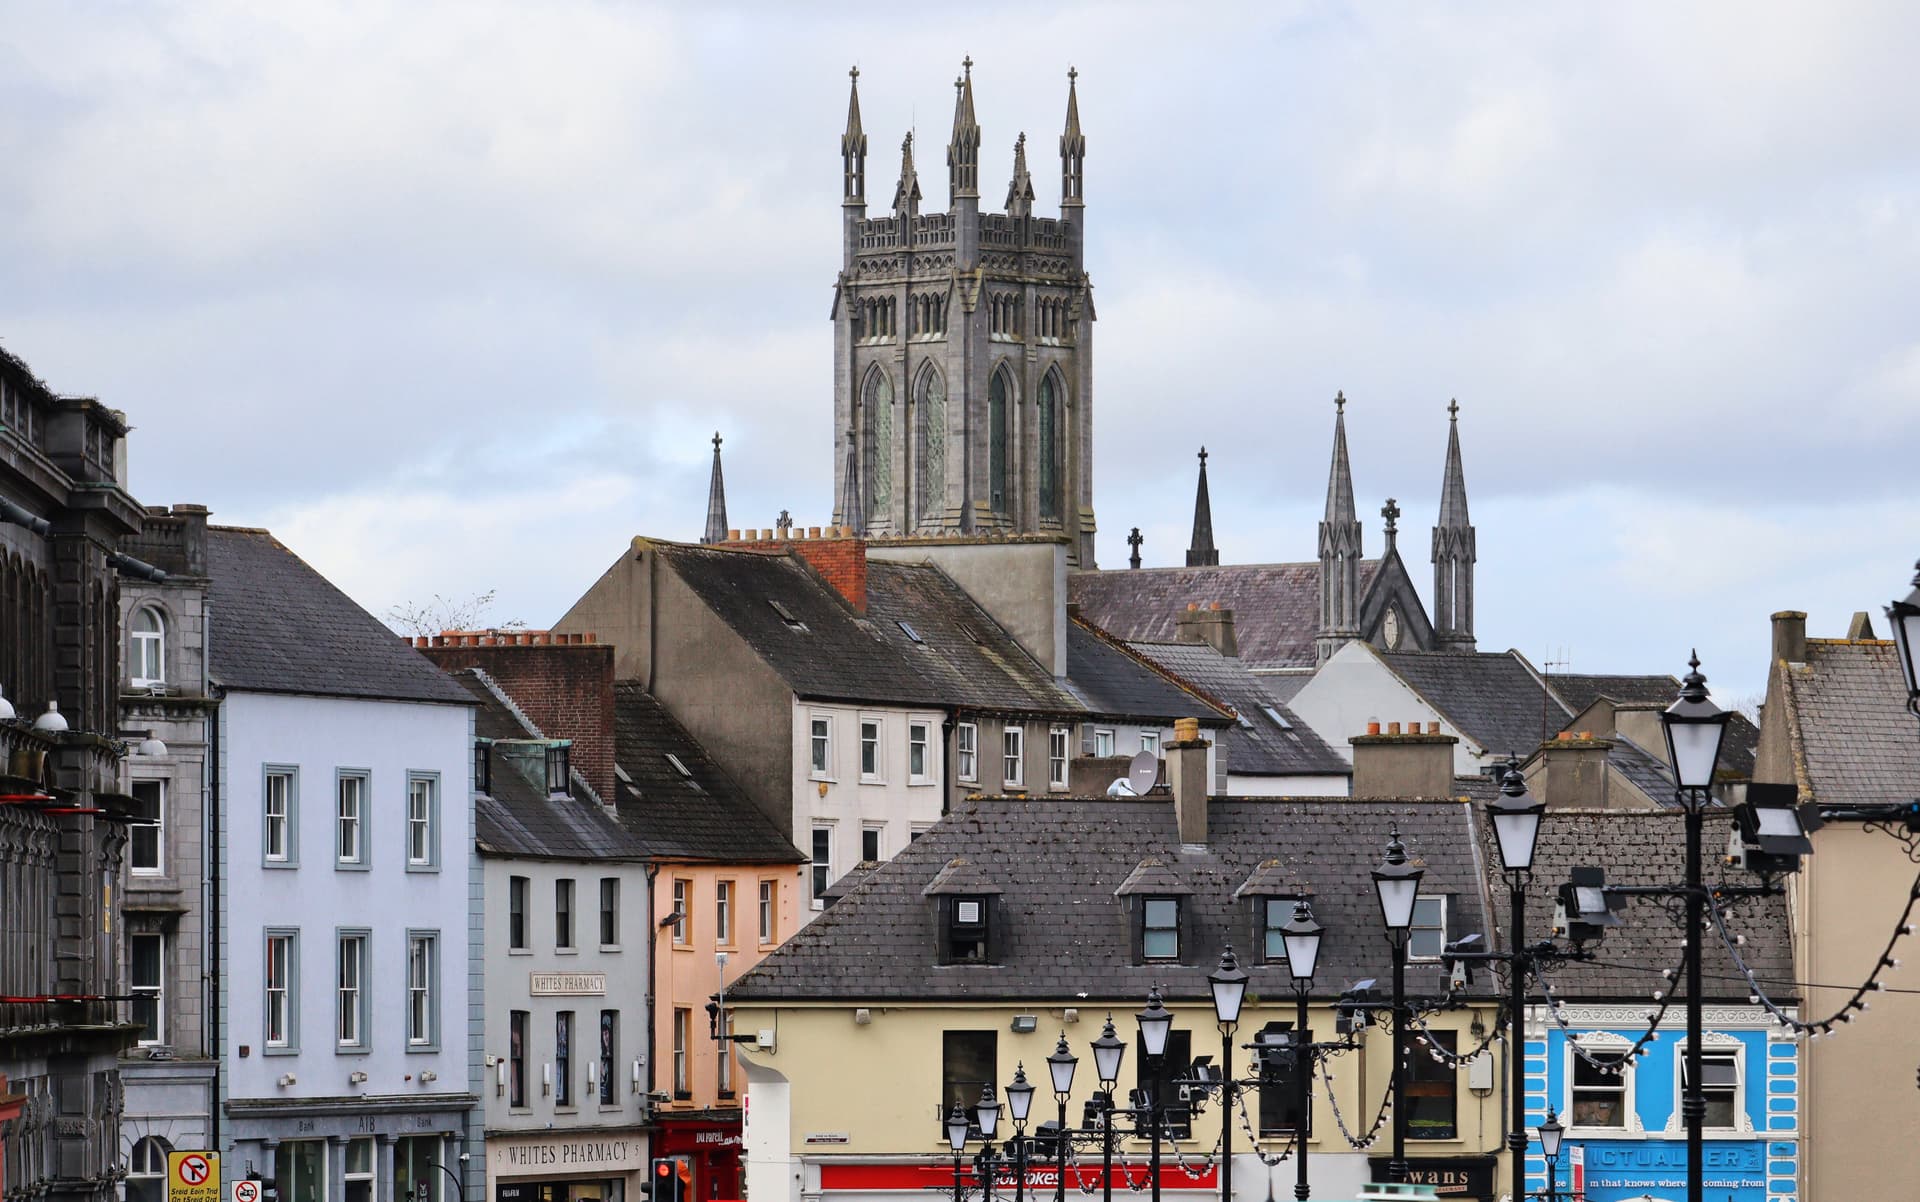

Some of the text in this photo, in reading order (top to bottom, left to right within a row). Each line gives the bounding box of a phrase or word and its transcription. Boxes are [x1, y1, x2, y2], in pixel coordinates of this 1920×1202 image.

[534, 977, 605, 990] WHITES PHARMACY
[358, 1115, 376, 1133] AIB
[509, 1145, 556, 1165] WHITES
[563, 1142, 629, 1163] PHARMACY
[634, 1144, 640, 1157] 5
[1591, 1150, 1740, 1167] ICTUALER
[1403, 1171, 1469, 1184] wans
[1601, 1178, 1621, 1188] that
[1624, 1178, 1656, 1188] knows
[1658, 1178, 1687, 1188] where
[1702, 1178, 1739, 1189] coming
[1741, 1178, 1765, 1188] from
